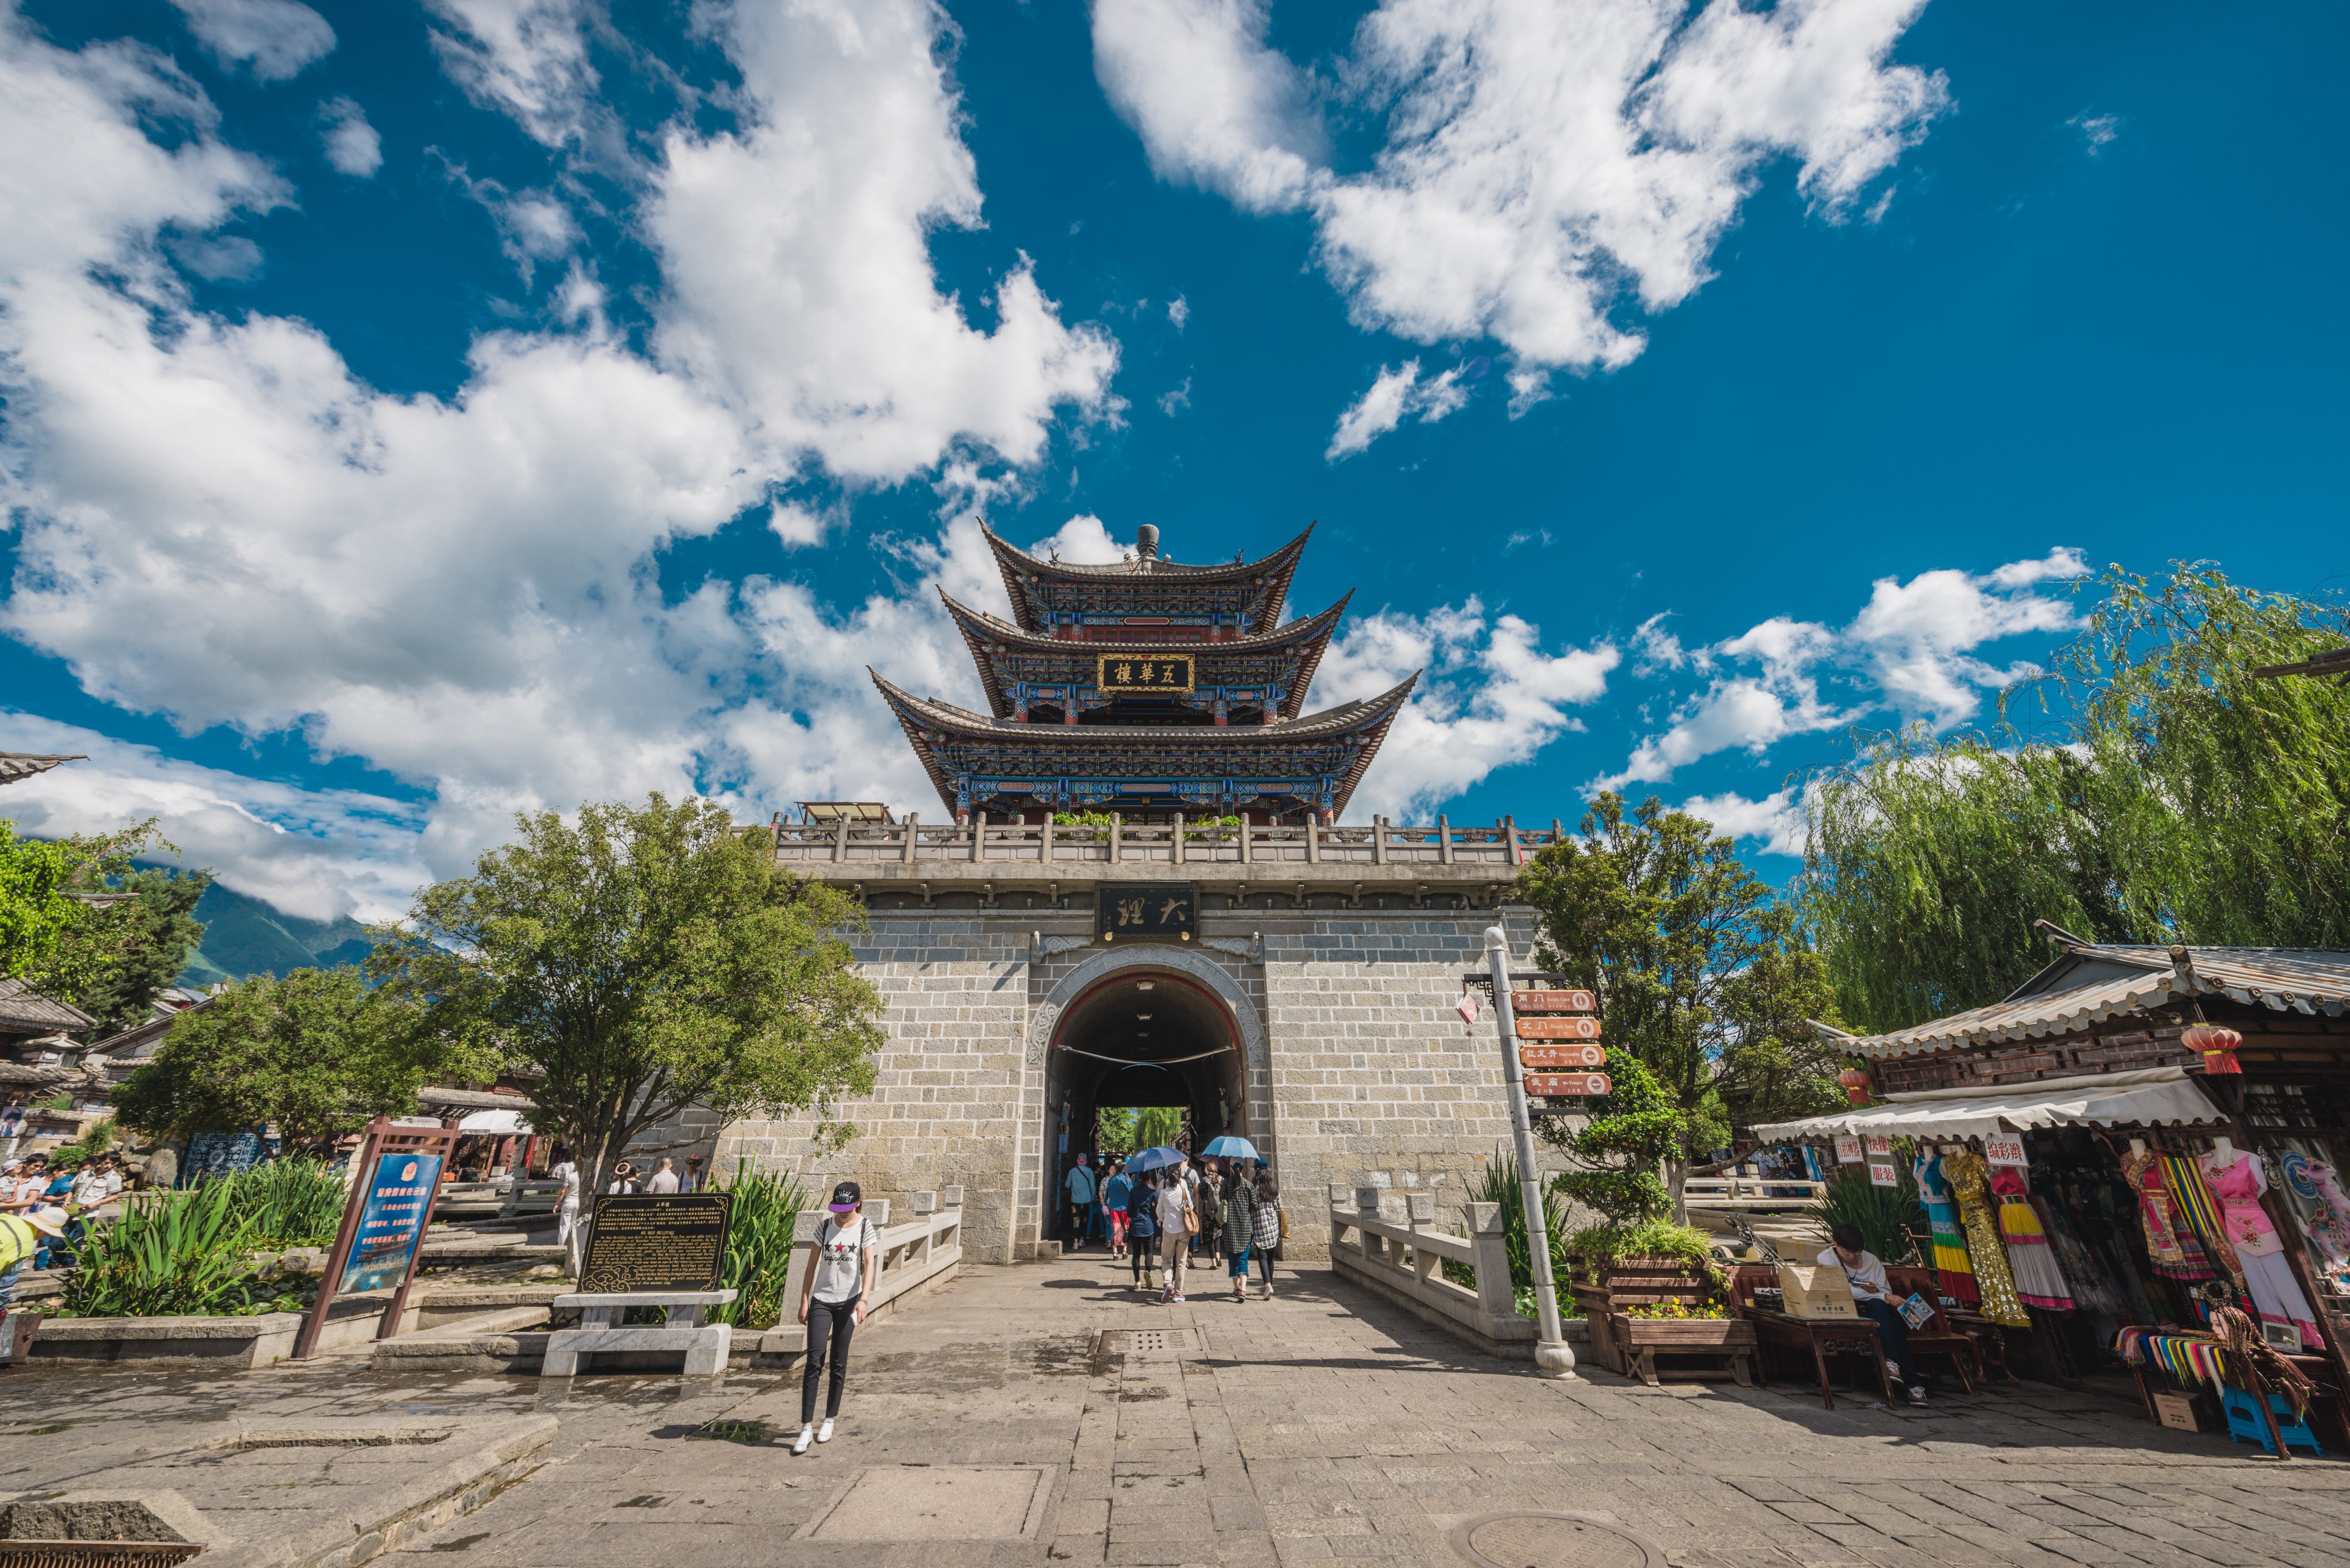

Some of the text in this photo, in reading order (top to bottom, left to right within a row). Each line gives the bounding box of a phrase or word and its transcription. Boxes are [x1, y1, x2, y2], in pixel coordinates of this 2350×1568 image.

[1114, 663, 1175, 684] 五華樓
[1117, 897, 1187, 926] 大理
[1518, 993, 1544, 1002] 南门
[1522, 1021, 1548, 1030] 北门
[1527, 1049, 1557, 1058] 红龙井
[1531, 1077, 1558, 1086] 武庙
[1837, 1141, 1860, 1158] 自拍神器
[1868, 1136, 1888, 1152] 快像
[1872, 1166, 1895, 1181] 服装
[835, 1195, 854, 1203] OBEY
